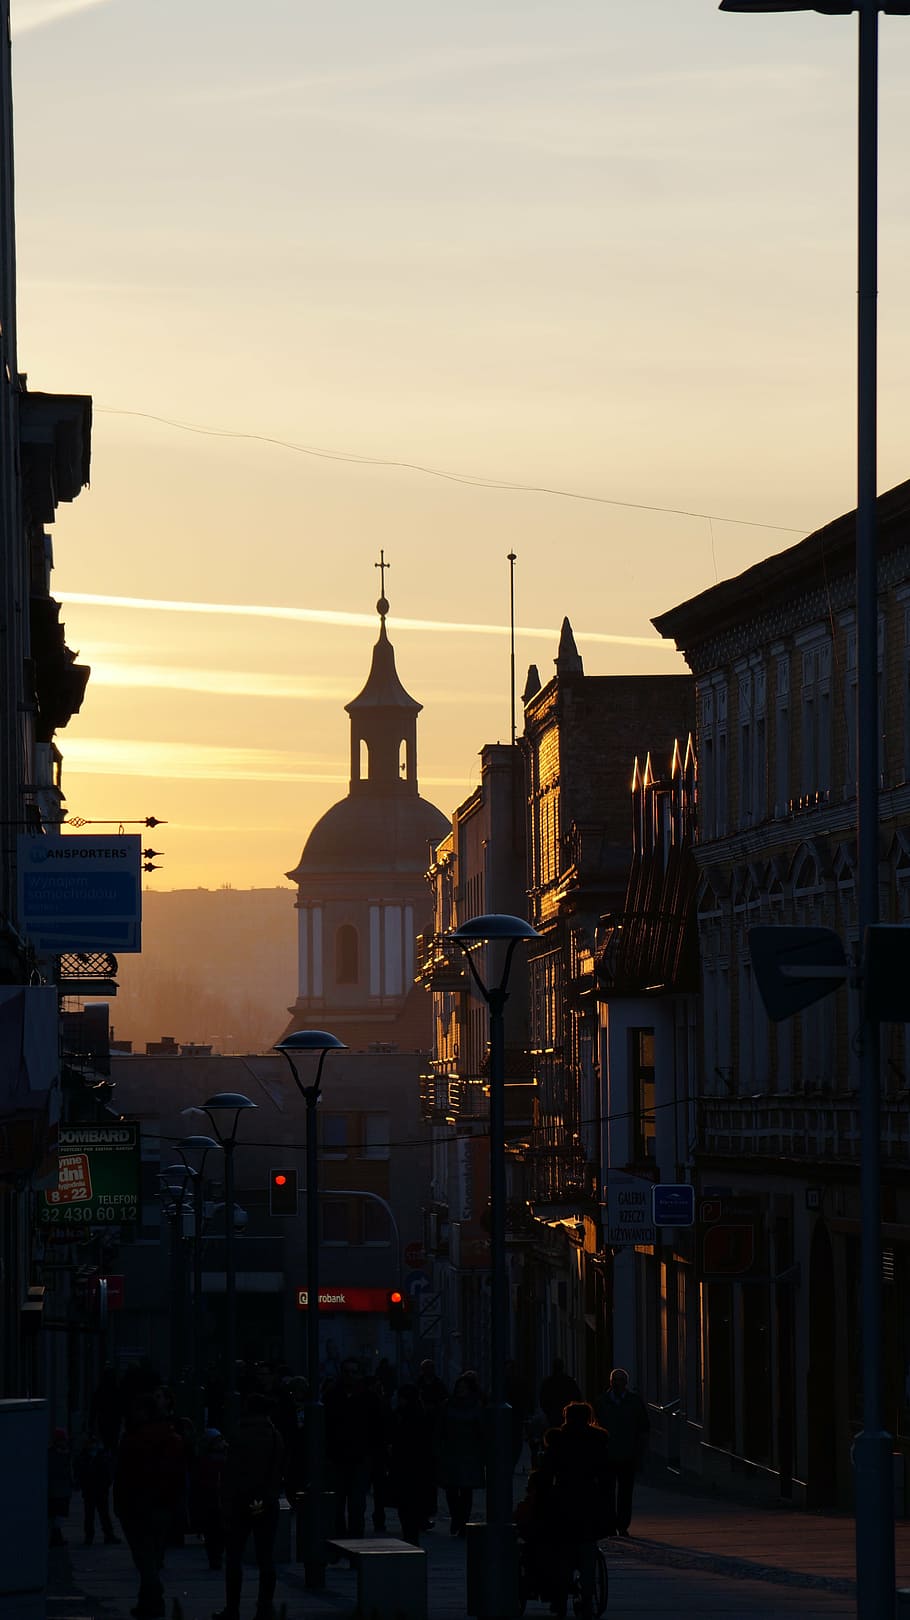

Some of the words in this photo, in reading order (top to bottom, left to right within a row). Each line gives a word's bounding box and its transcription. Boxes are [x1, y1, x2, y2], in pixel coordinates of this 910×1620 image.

[29, 877, 88, 889] wynajem
[58, 1157, 82, 1169] ynne
[59, 1166, 84, 1182] dni
[51, 1192, 60, 1202] 8
[71, 1188, 88, 1200] 22
[98, 1195, 137, 1204] TELEFON
[618, 1191, 645, 1205] GALERIA
[41, 1208, 60, 1222] 32
[64, 1208, 92, 1221] 430
[97, 1207, 115, 1220] 60
[120, 1207, 137, 1220] 12
[620, 1210, 645, 1223] RZECZY
[318, 1293, 346, 1303] robank
